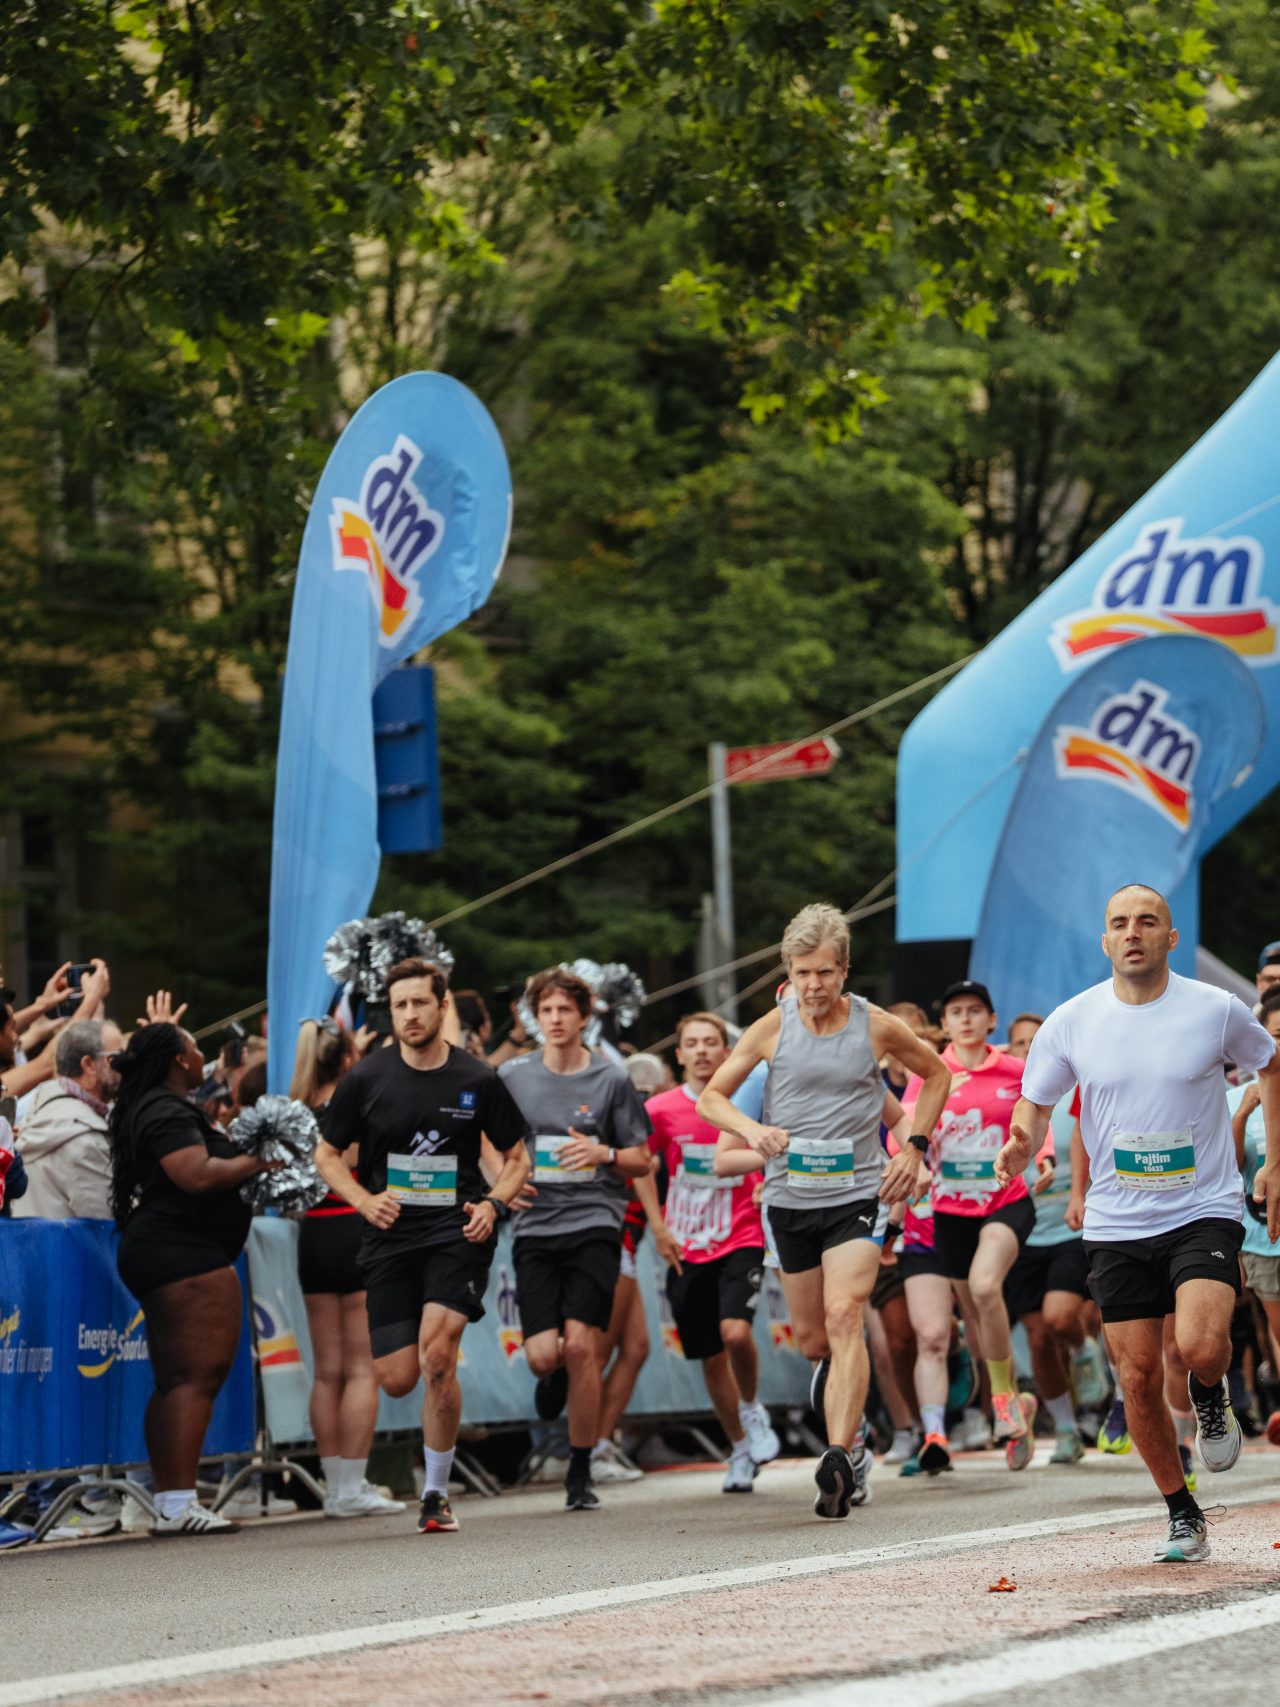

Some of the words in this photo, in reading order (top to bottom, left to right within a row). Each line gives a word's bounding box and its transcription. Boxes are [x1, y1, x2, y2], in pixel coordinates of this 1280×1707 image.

[365, 448, 436, 577] dm
[1104, 528, 1250, 609] dm
[1098, 688, 1196, 782] dm
[802, 1156, 837, 1167] Markus
[1134, 1152, 1171, 1166] Pajtim
[409, 1172, 435, 1182] Marc
[78, 1322, 118, 1356] Energie
